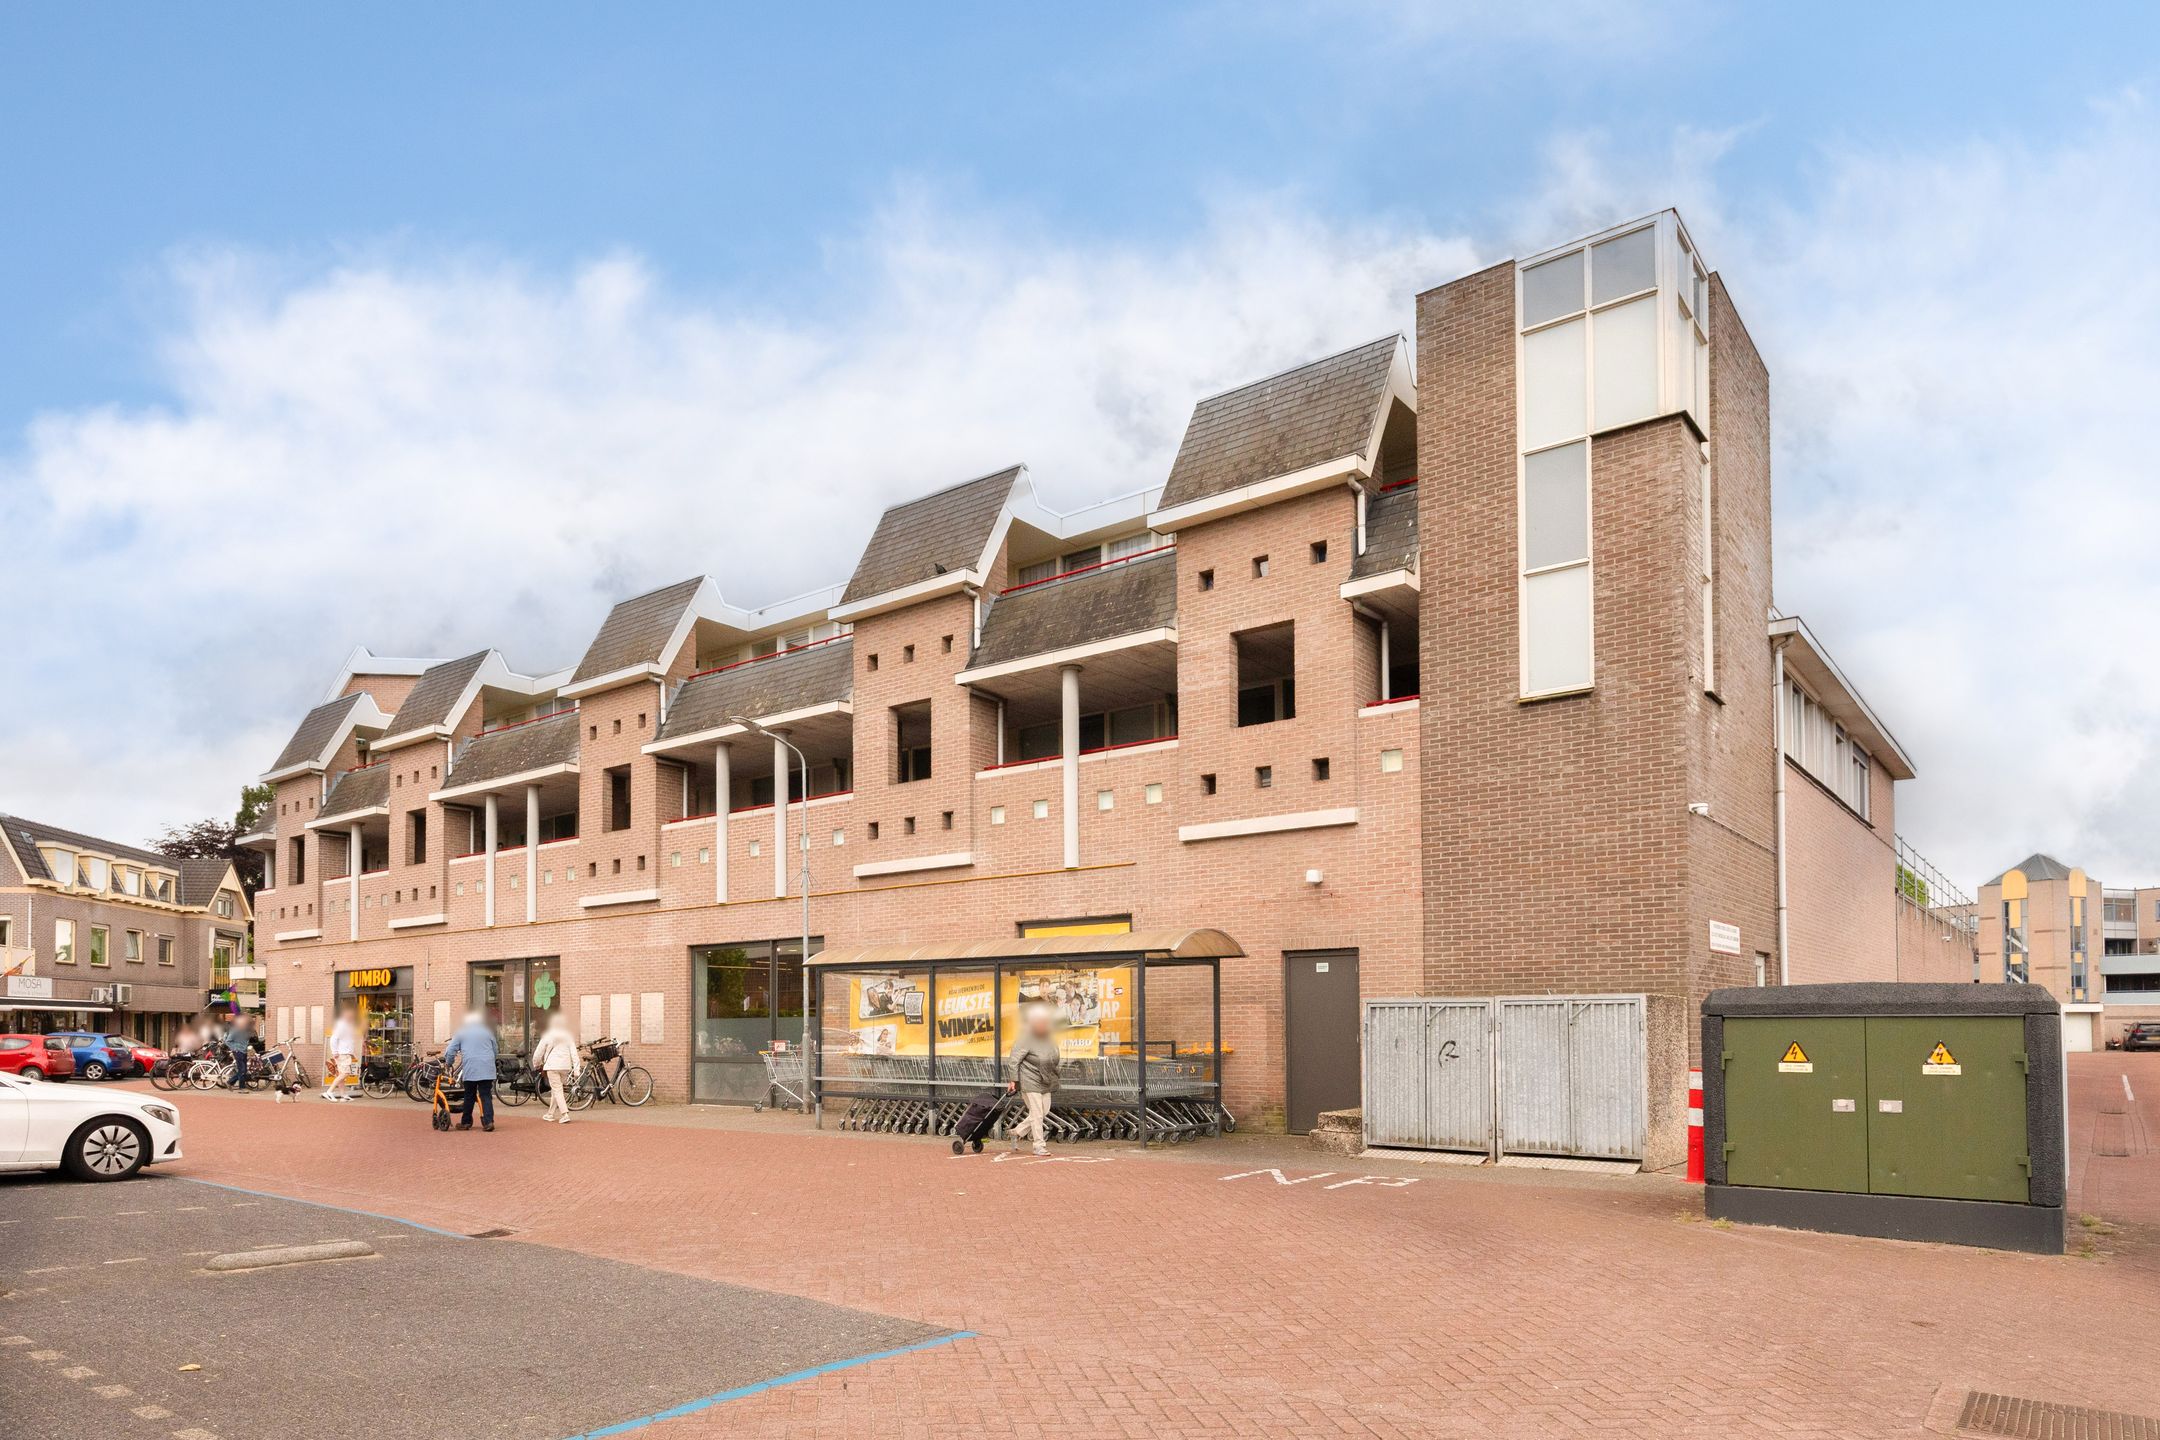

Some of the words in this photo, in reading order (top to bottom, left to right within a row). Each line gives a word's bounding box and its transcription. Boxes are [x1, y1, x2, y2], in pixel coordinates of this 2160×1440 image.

[18, 978, 42, 989] MOSA
[349, 969, 391, 988] JUMBO
[938, 991, 992, 1017] LEUKSTE
[937, 1013, 994, 1038] WINKEL
